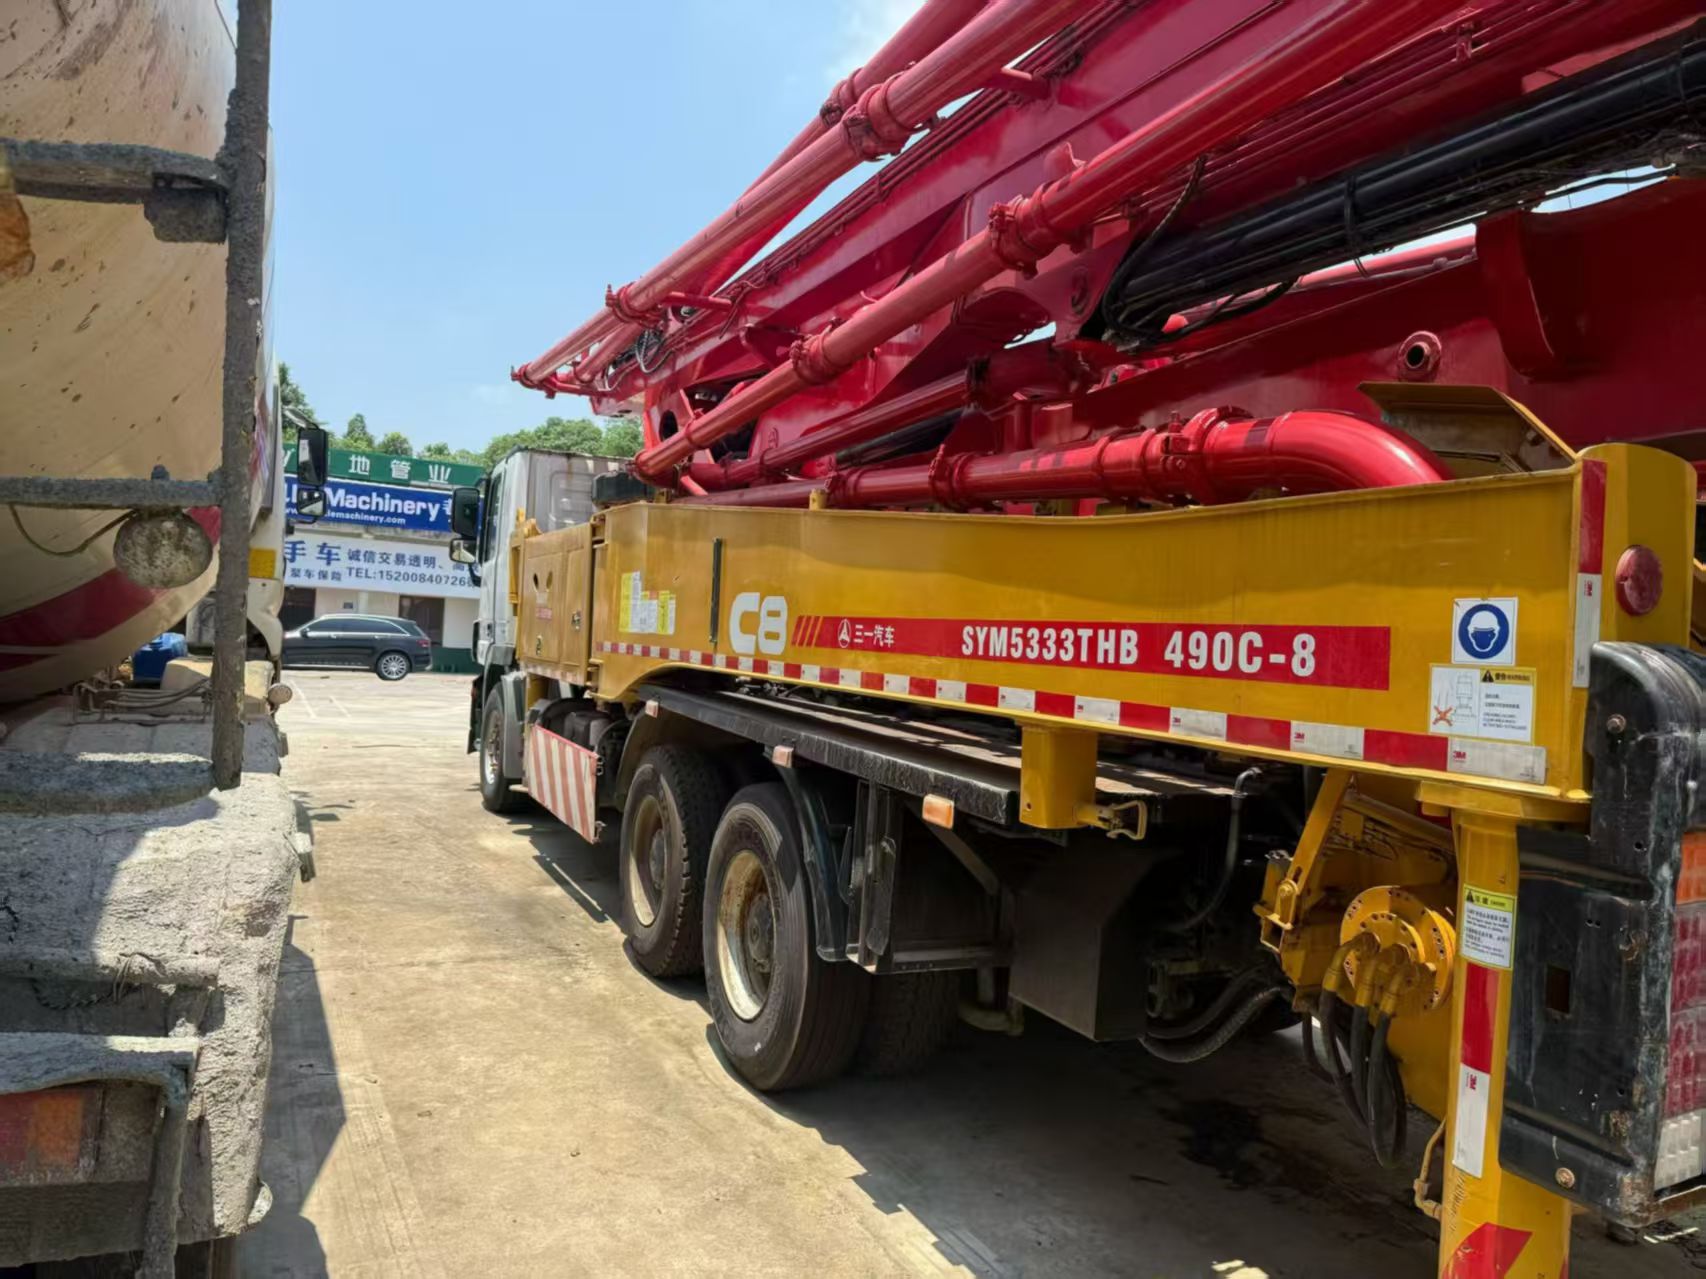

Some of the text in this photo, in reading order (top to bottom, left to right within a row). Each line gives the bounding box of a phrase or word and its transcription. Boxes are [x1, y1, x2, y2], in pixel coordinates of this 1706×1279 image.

[347, 454, 451, 484] 地管业
[323, 487, 440, 522] Machinery
[728, 592, 788, 656] C8
[853, 624, 895, 648] 三一汽车
[961, 625, 1317, 678] SYM5333THB 490C-8
[1294, 732, 1305, 740] 3M
[1453, 751, 1467, 760] 3M
[1469, 1074, 1478, 1090] 3M
